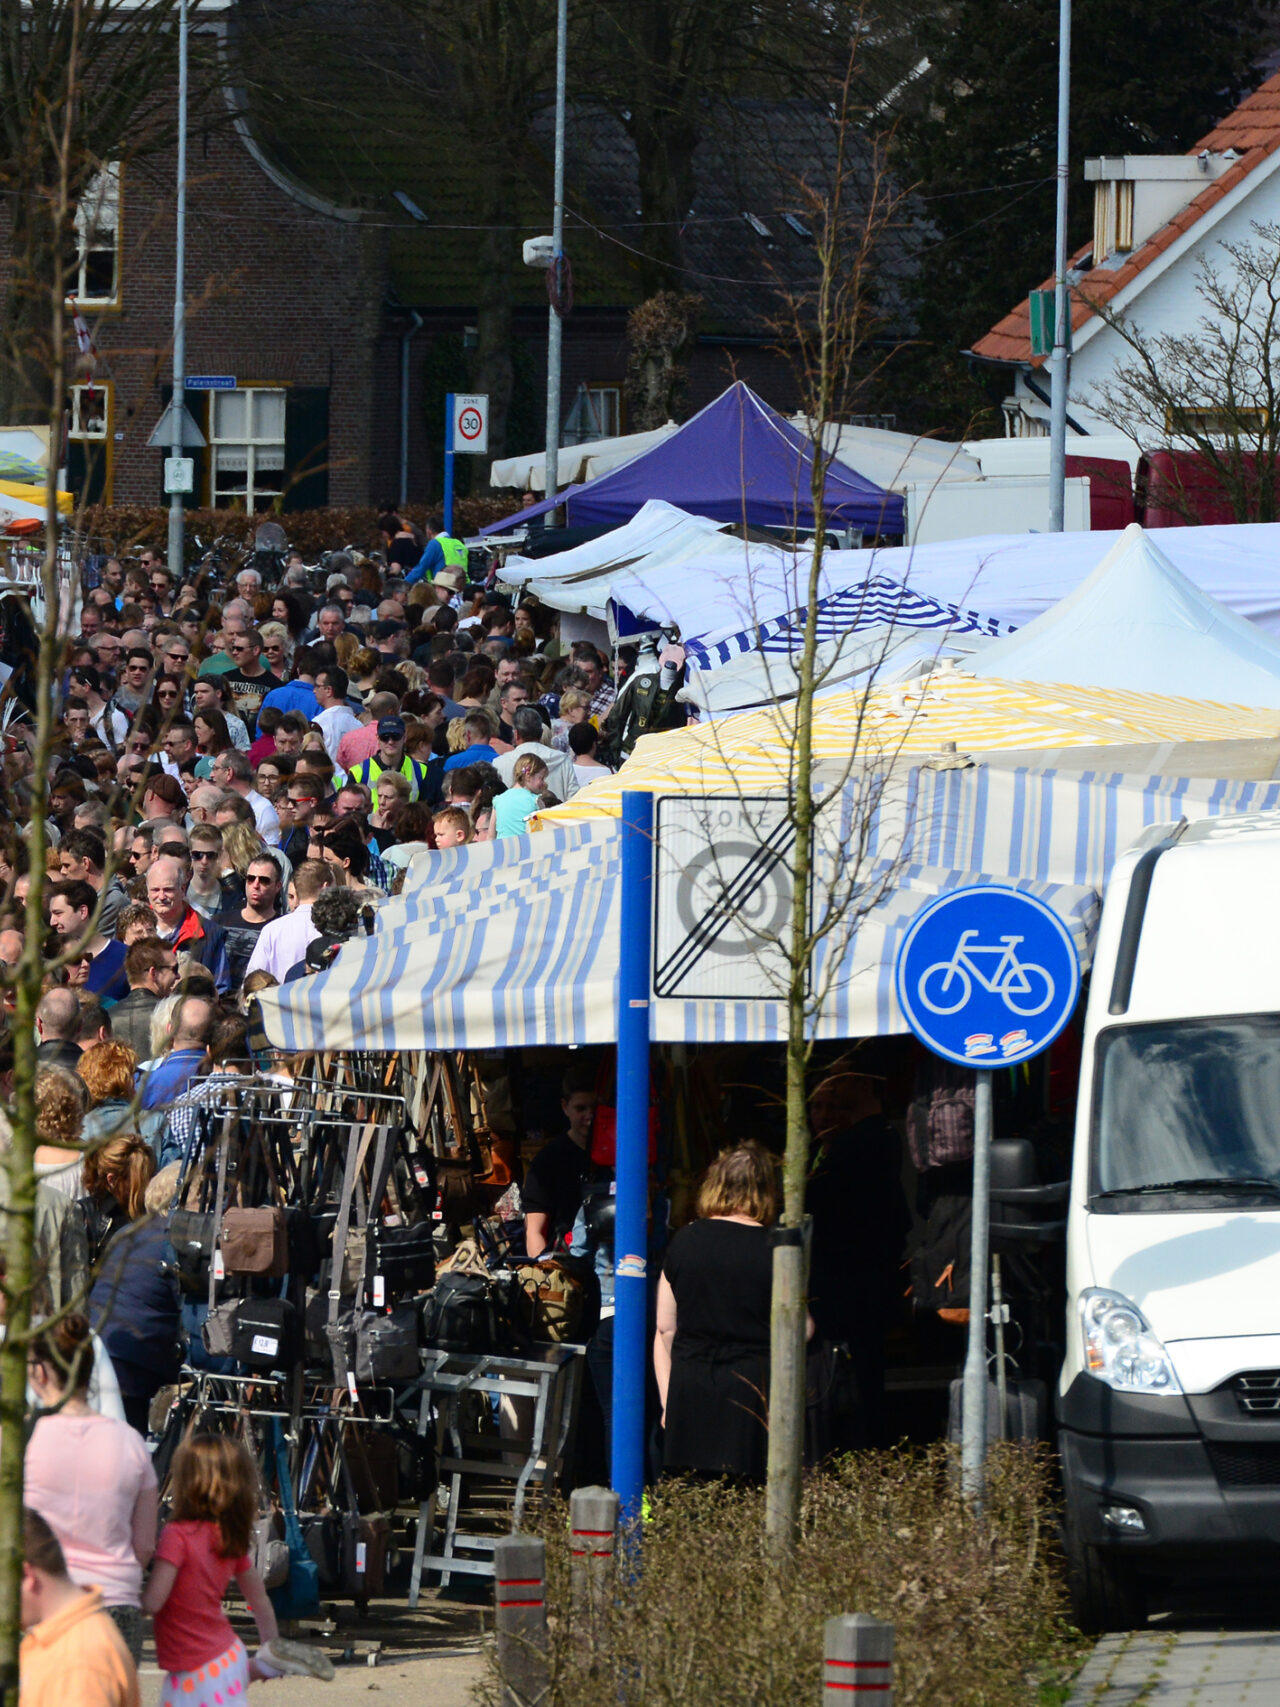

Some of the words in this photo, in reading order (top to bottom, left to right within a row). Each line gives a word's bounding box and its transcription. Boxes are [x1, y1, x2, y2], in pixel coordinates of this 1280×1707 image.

[463, 417, 479, 430] 30
[700, 810, 771, 828] ZONE
[704, 878, 768, 918] 30
